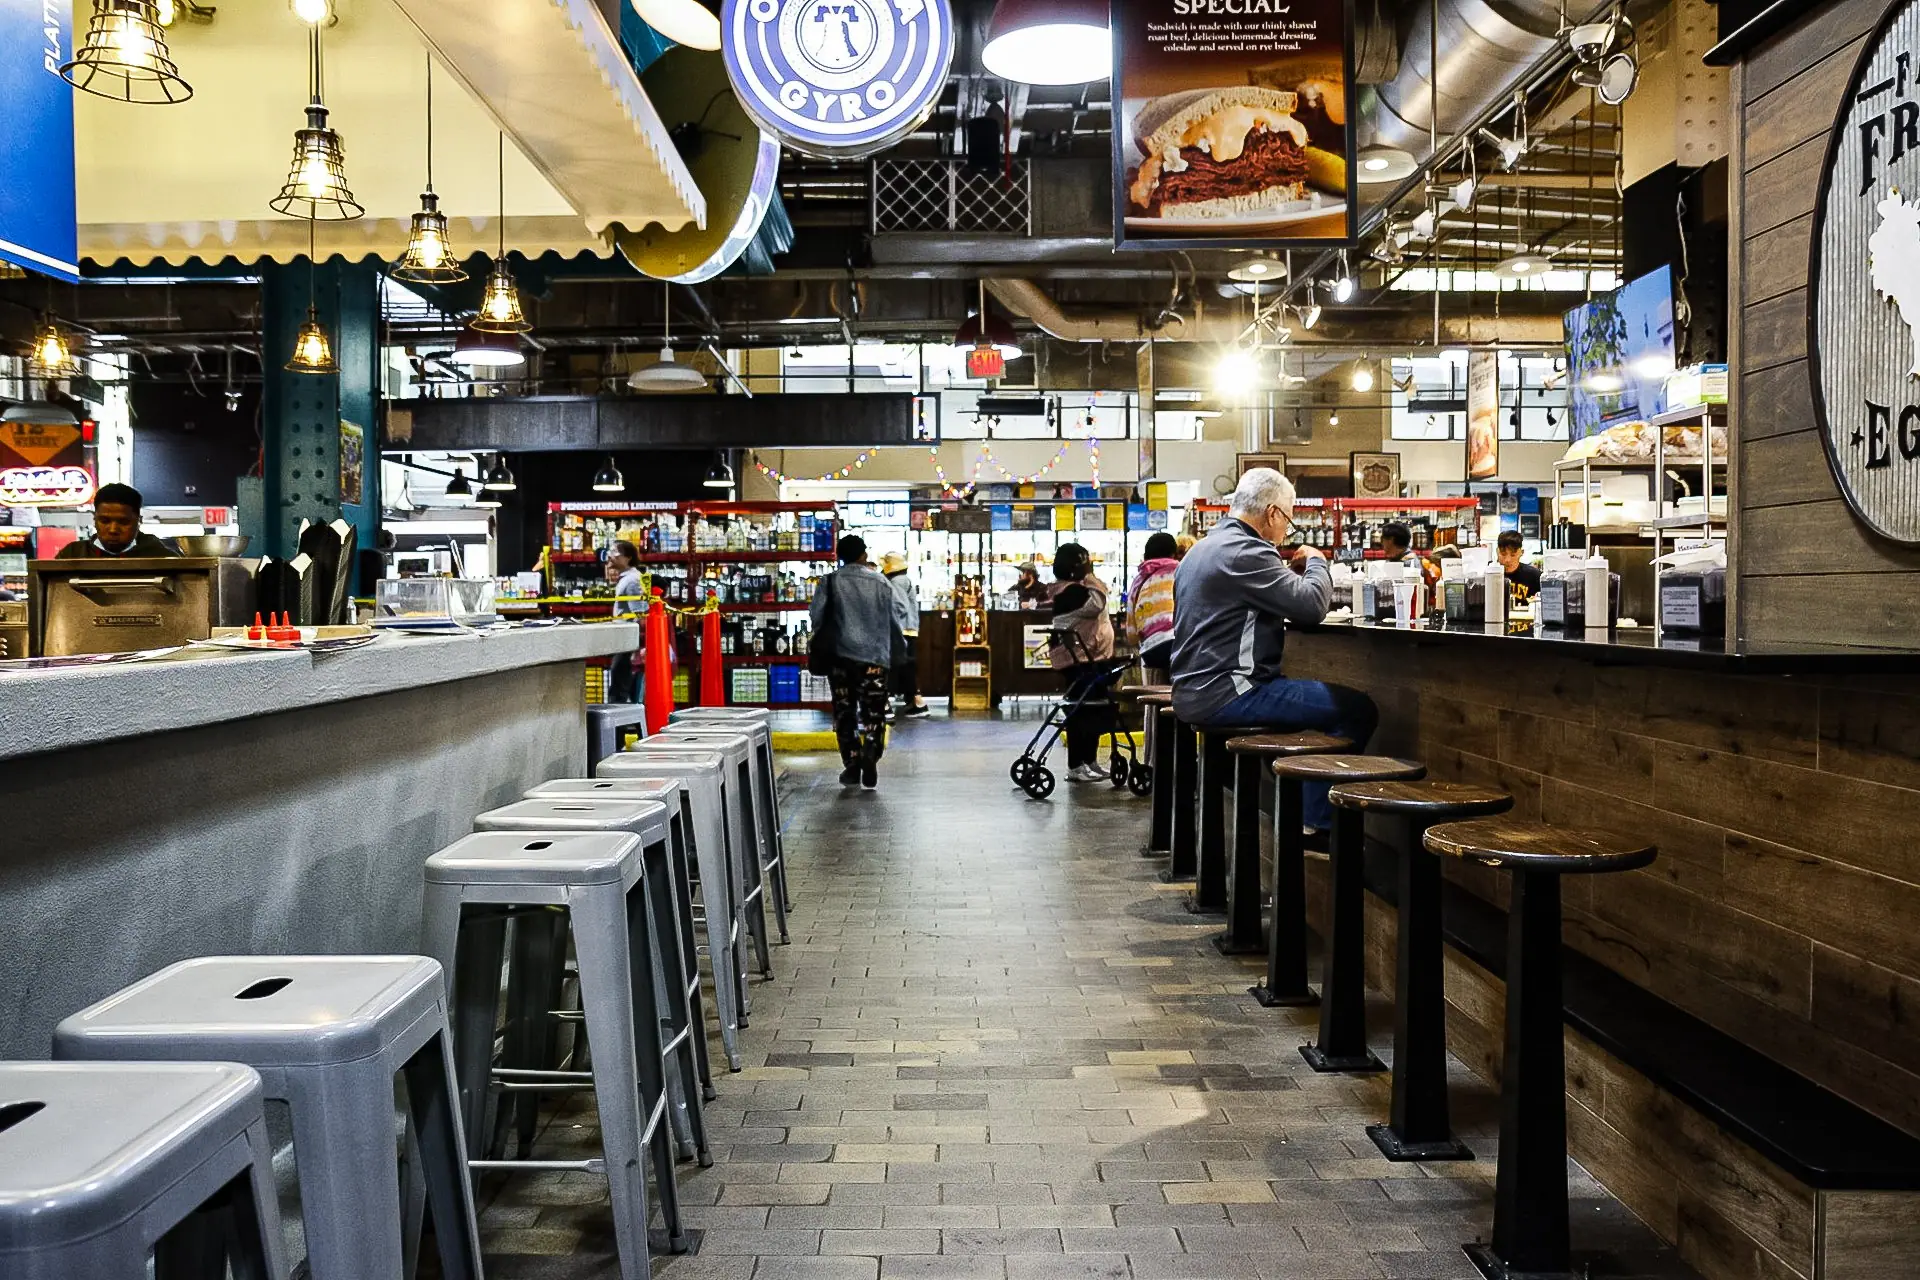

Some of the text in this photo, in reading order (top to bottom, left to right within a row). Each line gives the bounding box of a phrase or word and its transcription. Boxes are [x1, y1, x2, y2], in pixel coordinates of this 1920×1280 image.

[1173, 0, 1290, 15] SPECIAL
[1147, 22, 1188, 31] Sandwich
[1190, 22, 1197, 30] is
[1198, 21, 1222, 30] made
[1223, 21, 1243, 30] with
[1261, 21, 1287, 30] thinly
[1288, 20, 1317, 29] shaved
[1147, 33, 1168, 41] roast
[1170, 32, 1190, 41] beef,
[1192, 32, 1230, 41] delicious
[1231, 31, 1278, 40] homemade
[1163, 42, 1198, 52] coleslaw
[1199, 42, 1216, 51] and
[1217, 42, 1244, 51] served
[1274, 41, 1302, 50] bread.
[778, 79, 897, 121] GYRO
[971, 350, 1001, 377] EXIT
[560, 501, 678, 511] PENNSYLVANIA LIBATIONS
[205, 507, 228, 525] EXIT
